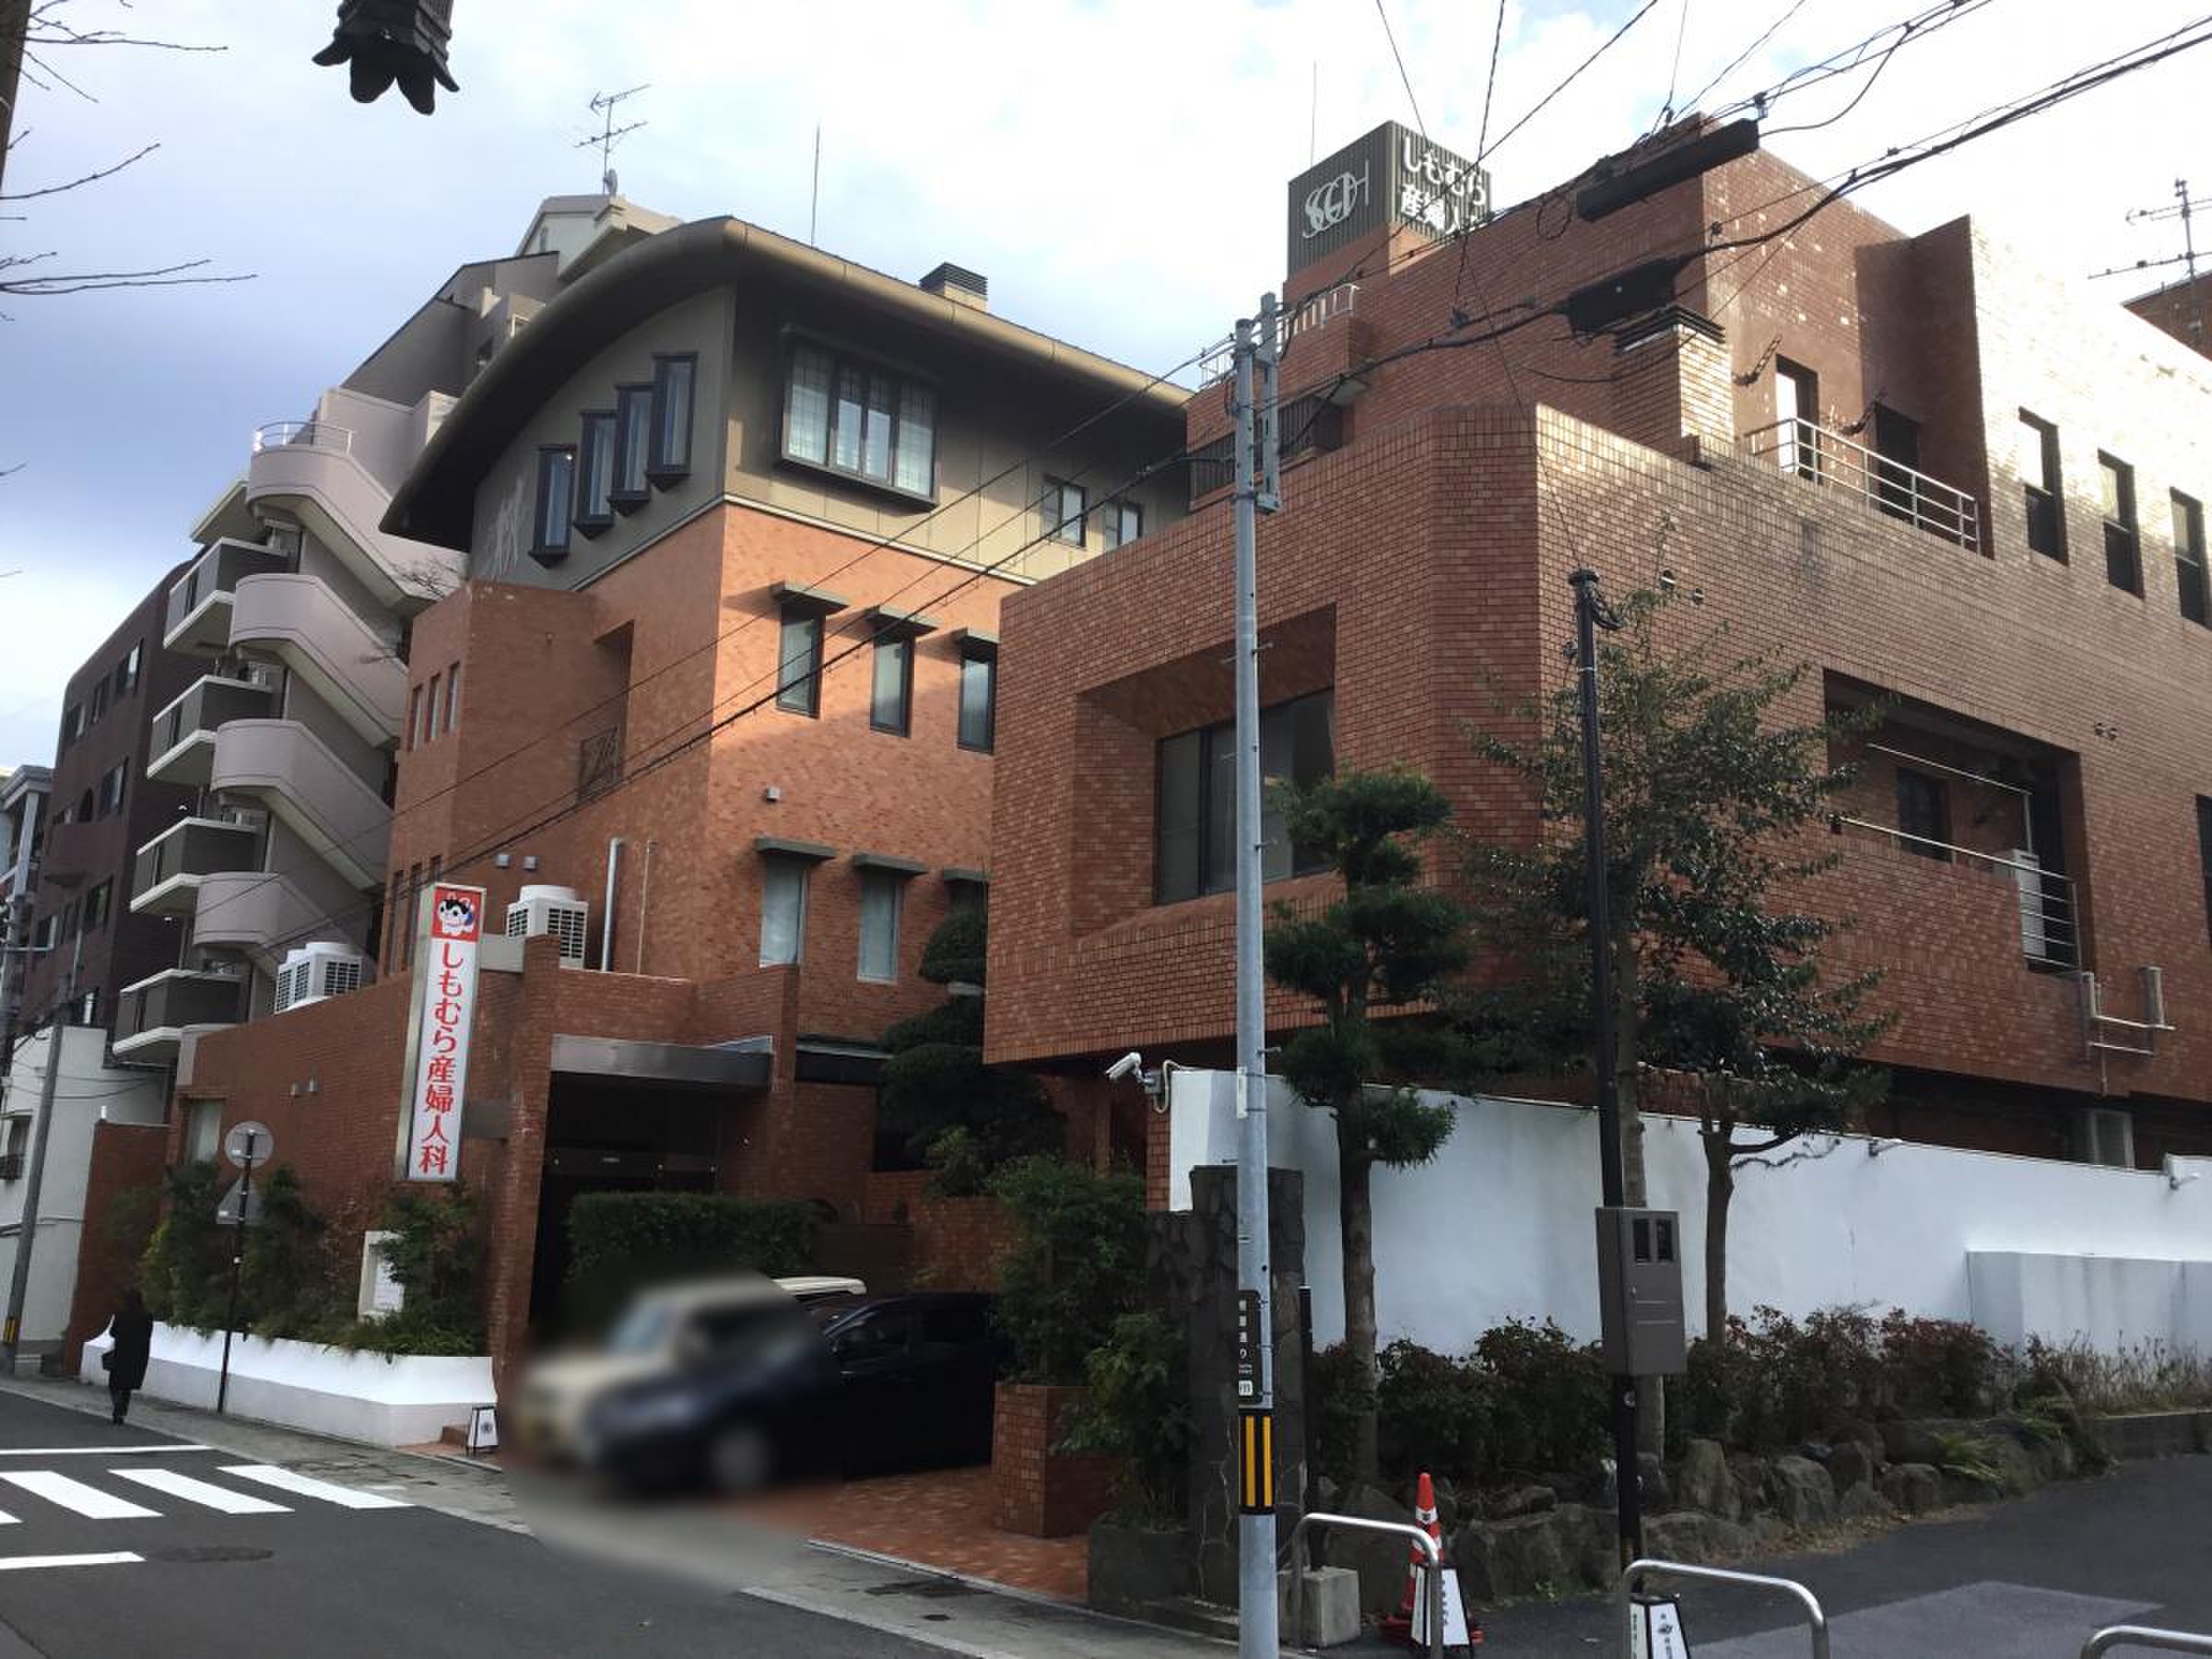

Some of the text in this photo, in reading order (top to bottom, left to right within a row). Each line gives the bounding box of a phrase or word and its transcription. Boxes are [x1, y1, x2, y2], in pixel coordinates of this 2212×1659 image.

[418, 942, 464, 1176] しもむら産婦人科
